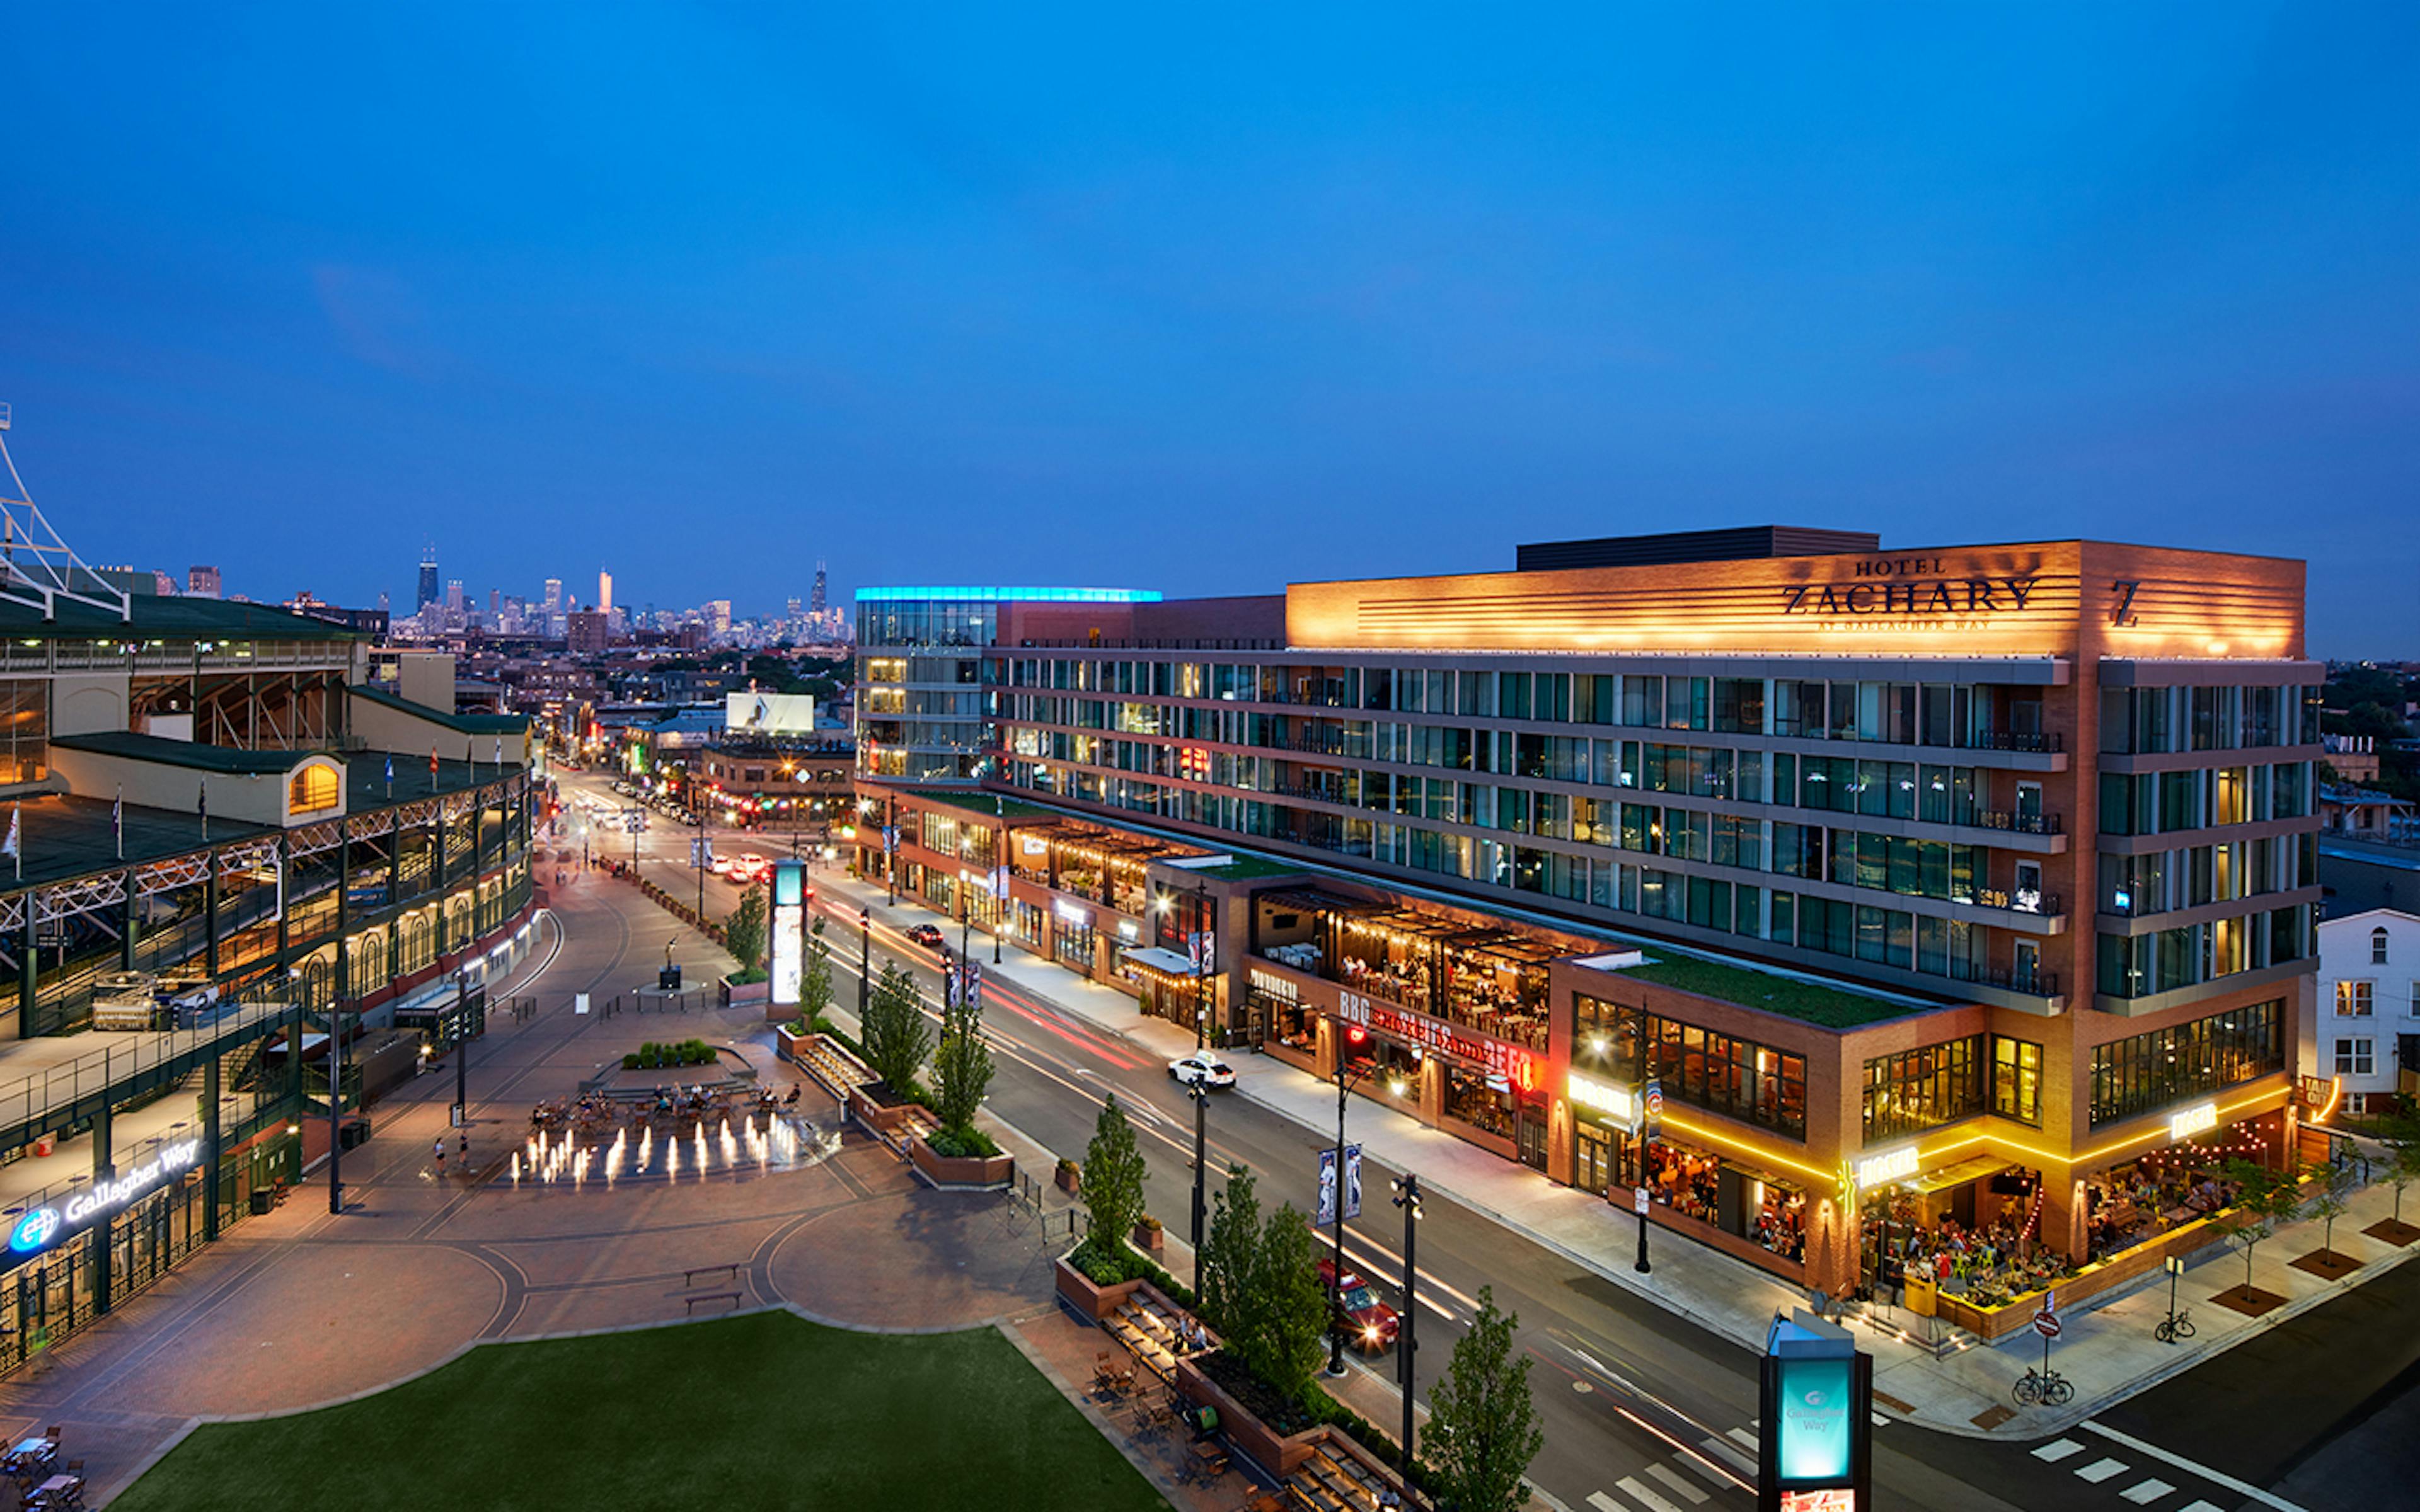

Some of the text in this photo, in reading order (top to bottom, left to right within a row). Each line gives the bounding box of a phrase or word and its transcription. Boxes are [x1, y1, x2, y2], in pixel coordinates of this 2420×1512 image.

[1855, 559, 1946, 576] HOTEL
[1782, 577, 2040, 614] ZACHARY
[2112, 580, 2141, 627] Z
[1845, 621, 1944, 630] GALLAGHER
[1955, 621, 1990, 630] WAY
[66, 1139, 198, 1221] Gallagher Way
[1786, 1408, 1845, 1420] Gallagher
[1803, 1420, 1829, 1432] Way
